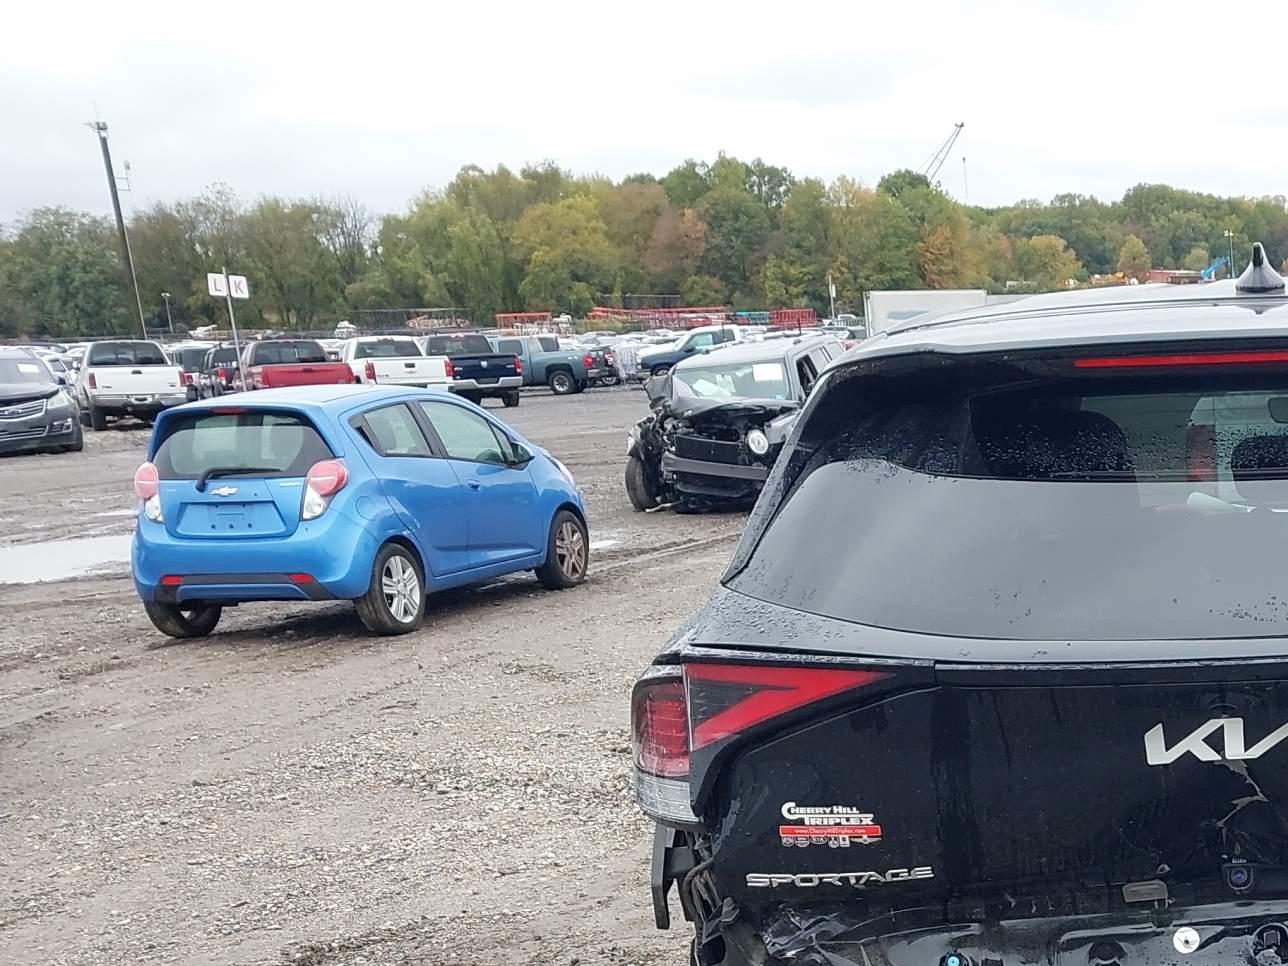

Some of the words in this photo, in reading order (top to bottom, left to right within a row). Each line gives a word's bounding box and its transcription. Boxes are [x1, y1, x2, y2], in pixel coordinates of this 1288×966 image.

[213, 277, 222, 292] L
[234, 280, 244, 294] K
[781, 801, 832, 820] CHERRY
[832, 805, 860, 814] HILL
[803, 814, 875, 826] TRIPLEX
[745, 866, 935, 888] SPORTAGE
